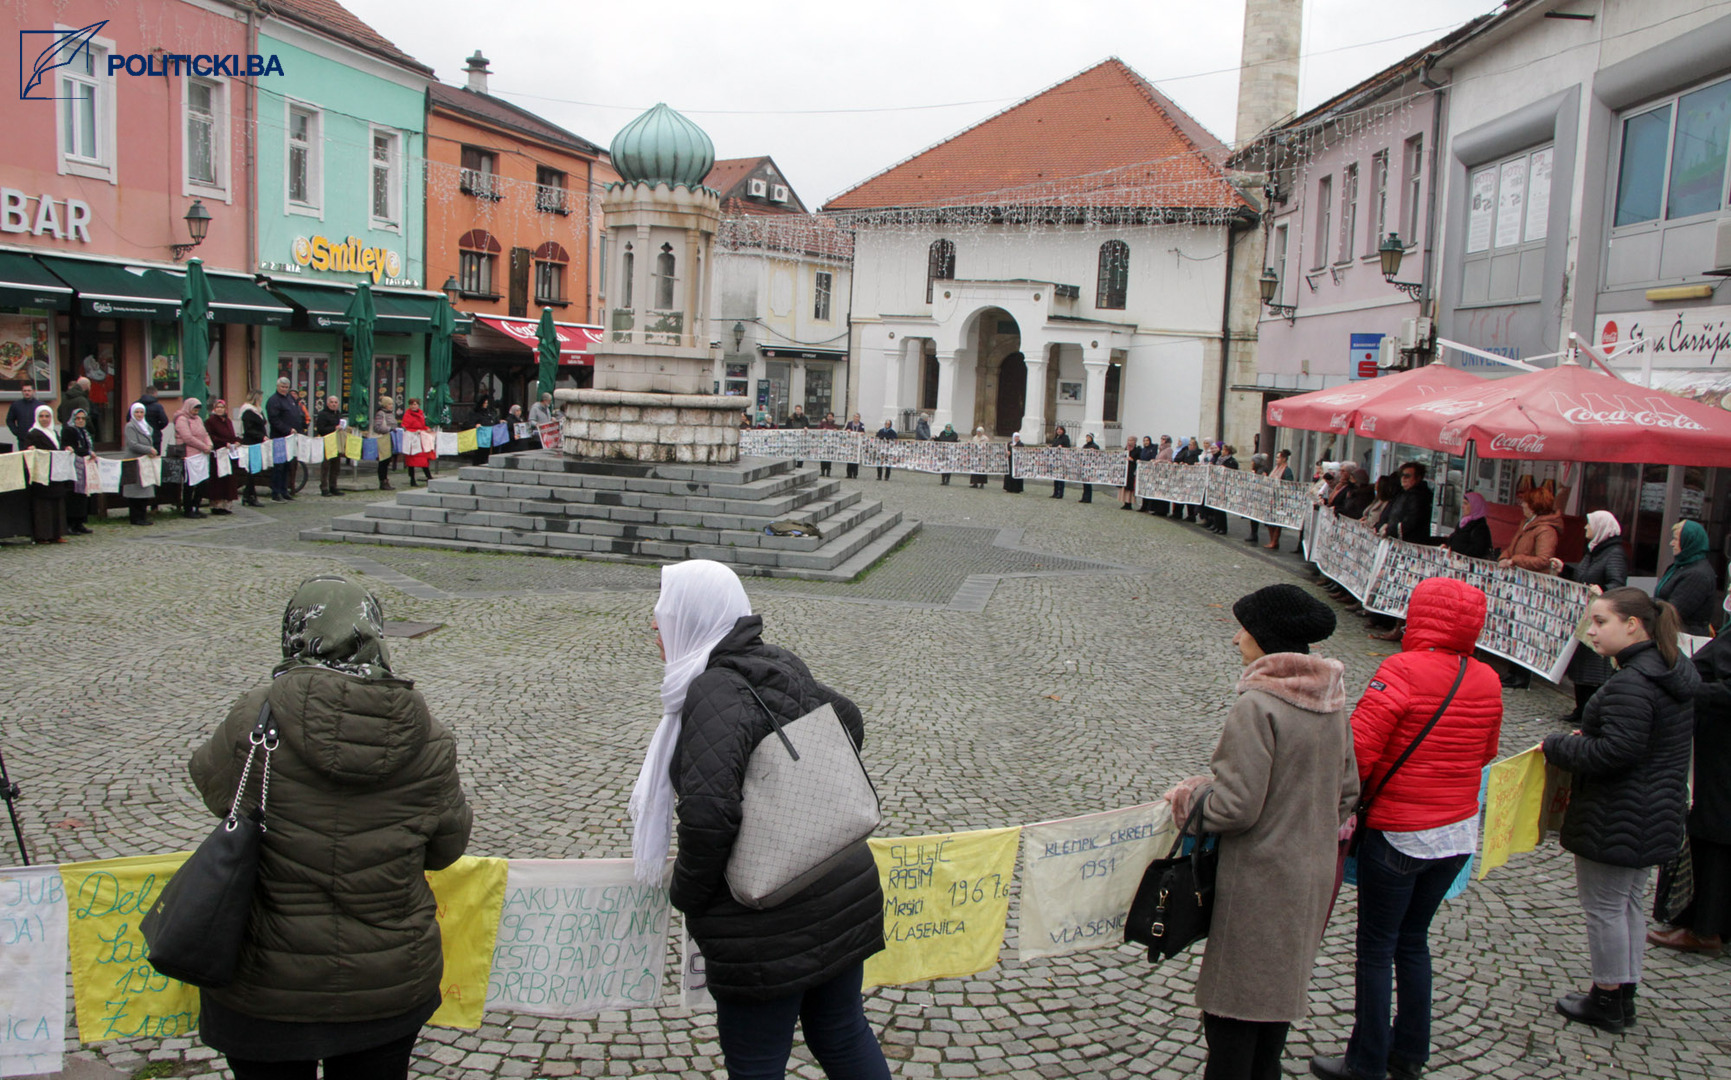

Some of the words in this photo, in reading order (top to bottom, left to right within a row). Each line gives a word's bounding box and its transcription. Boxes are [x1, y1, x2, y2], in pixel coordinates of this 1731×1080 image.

[0, 187, 91, 243] BAR
[311, 235, 387, 285] Smiley
[1564, 406, 1711, 432] Coca-Cola
[1490, 433, 1548, 454] Coca-Cola
[1080, 857, 1116, 880] 1951
[77, 871, 158, 919] Del
[556, 908, 666, 945] BRATUNAC
[884, 919, 966, 942] VLASENICA
[1050, 912, 1128, 943] VLASENIC
[491, 944, 551, 972] ESTO
[115, 964, 184, 995] 195
[487, 968, 634, 1006] SREBRENICE
[0, 1014, 50, 1042] ICA
[101, 997, 200, 1038] Zvor
